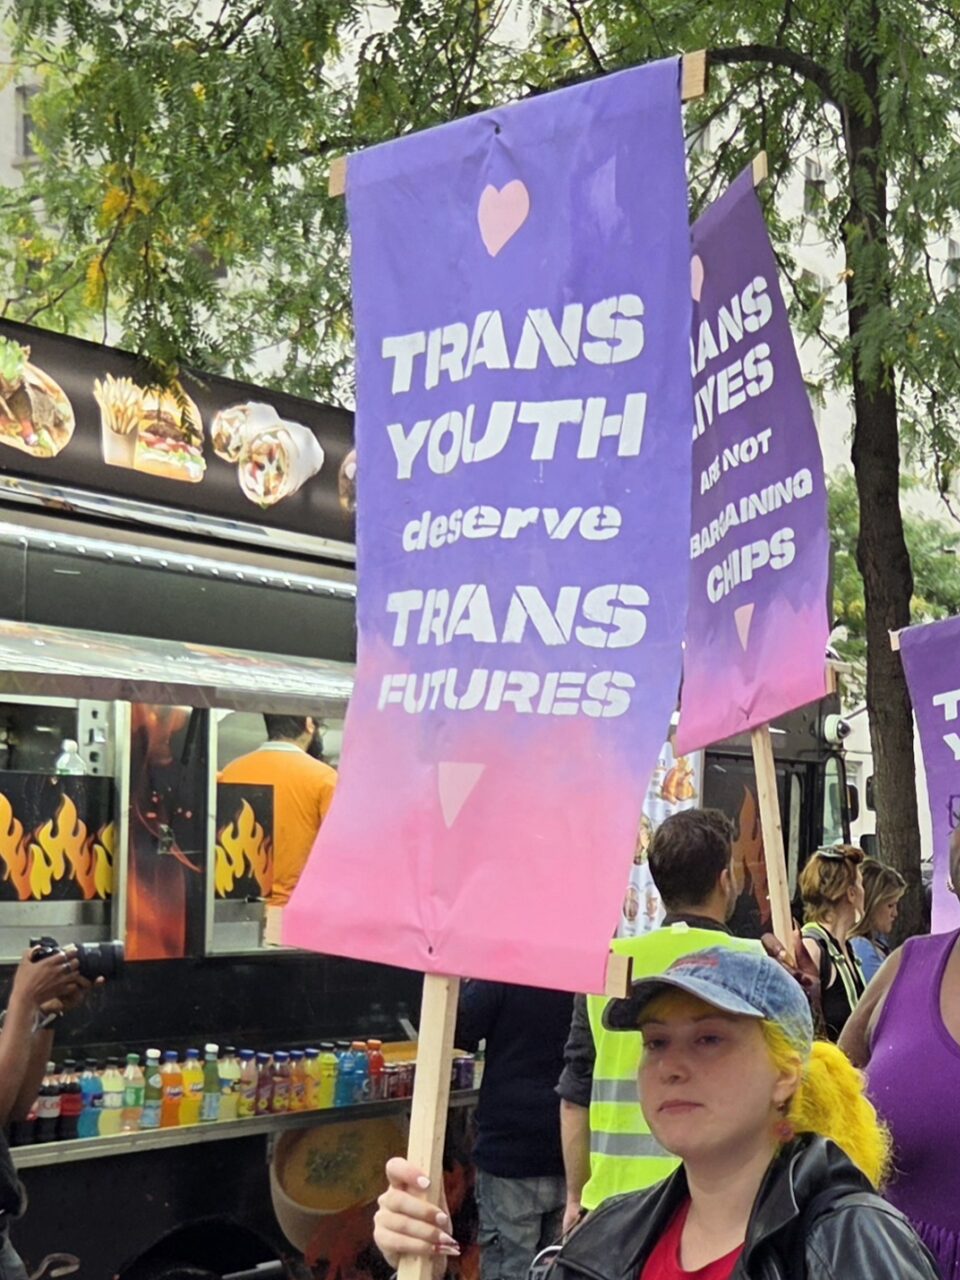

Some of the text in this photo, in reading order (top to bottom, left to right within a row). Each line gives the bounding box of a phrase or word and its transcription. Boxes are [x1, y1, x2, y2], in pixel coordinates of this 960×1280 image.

[381, 293, 645, 395] TRANS
[690, 275, 774, 378] ANS
[690, 342, 774, 440] IVES
[386, 392, 647, 480] YOUTH
[722, 427, 772, 472] NOT
[401, 505, 622, 553] deserve
[707, 527, 796, 604] CHIPS
[385, 584, 650, 649] TRANS
[377, 667, 636, 718] FUTURES
